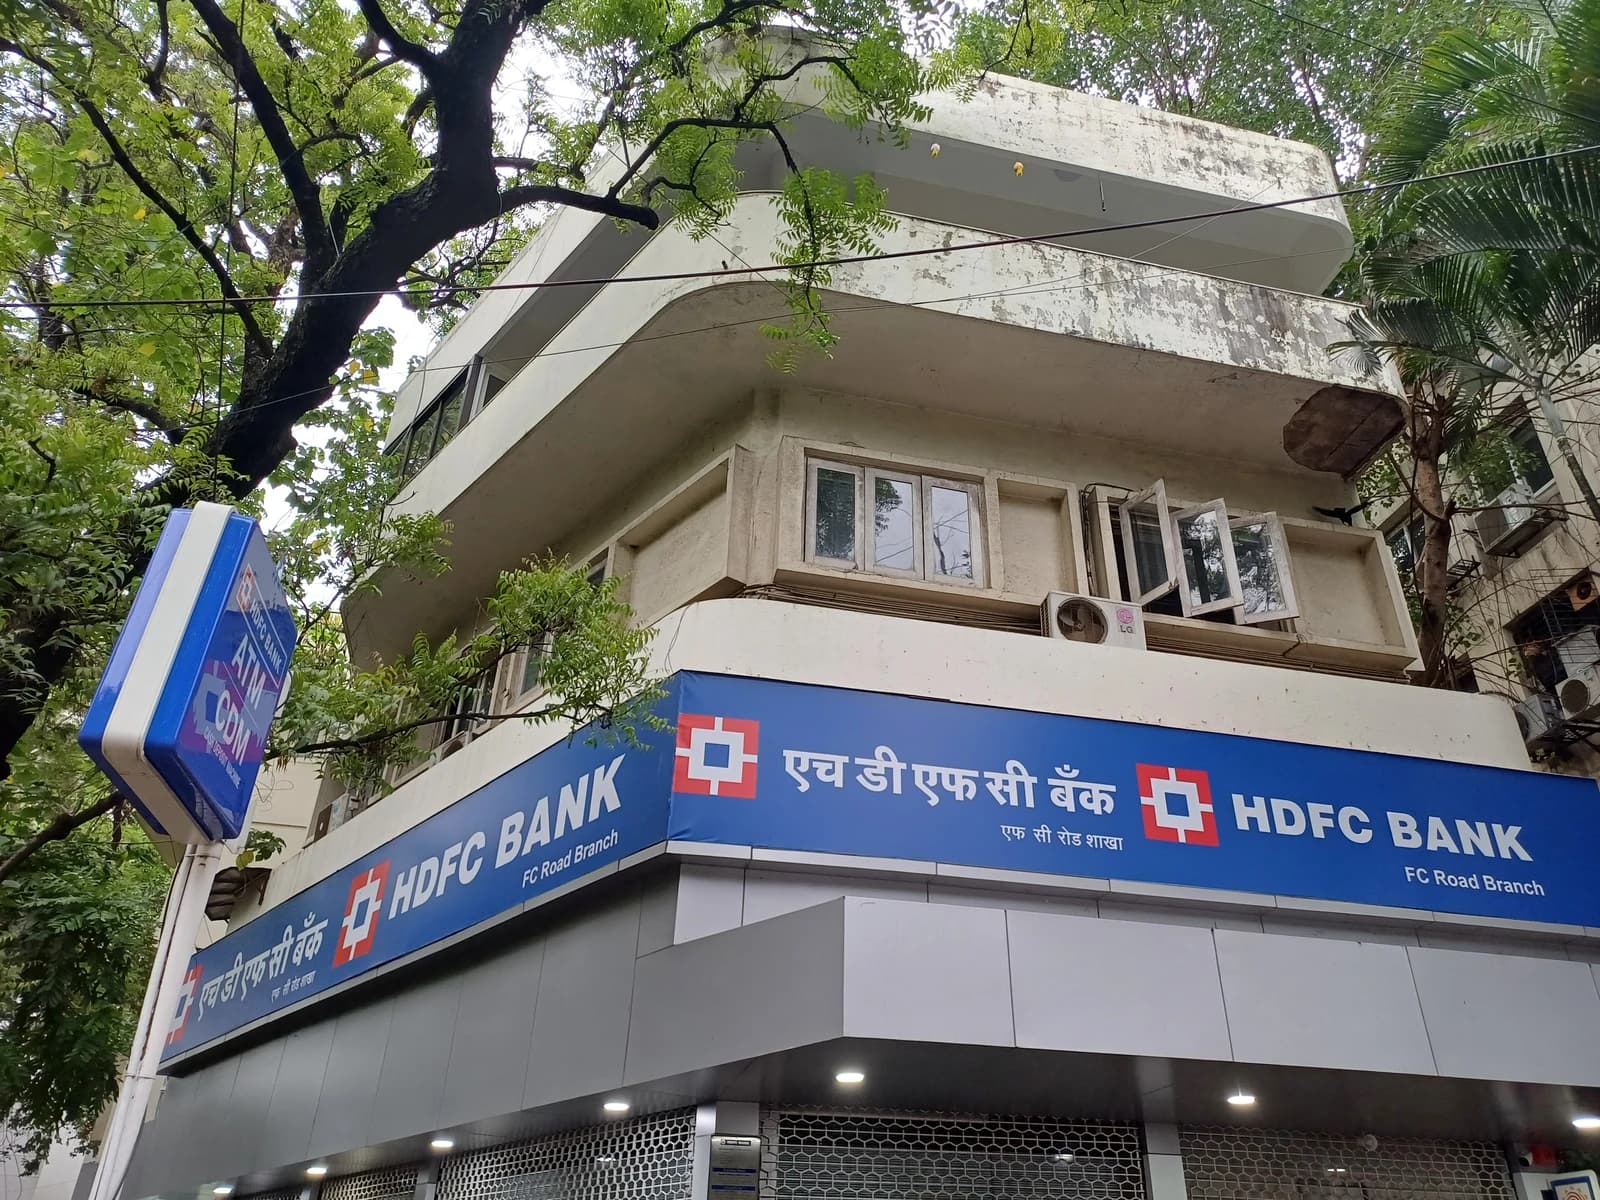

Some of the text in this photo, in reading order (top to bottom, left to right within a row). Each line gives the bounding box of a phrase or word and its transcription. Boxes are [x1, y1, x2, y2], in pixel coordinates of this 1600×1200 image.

[249, 598, 282, 675] HDFC BANK
[1120, 625, 1134, 634] LG
[231, 634, 266, 710] ATM
[215, 690, 251, 766] CDM
[1048, 764, 1116, 815] बँक
[388, 753, 626, 920] HDFC BANK
[522, 829, 618, 888] FC Road Branch
[1000, 824, 1124, 851] एफ सी रोड शाखा
[1231, 793, 1534, 862] HDFC BANK
[1404, 866, 1545, 897] FC Road Branch
